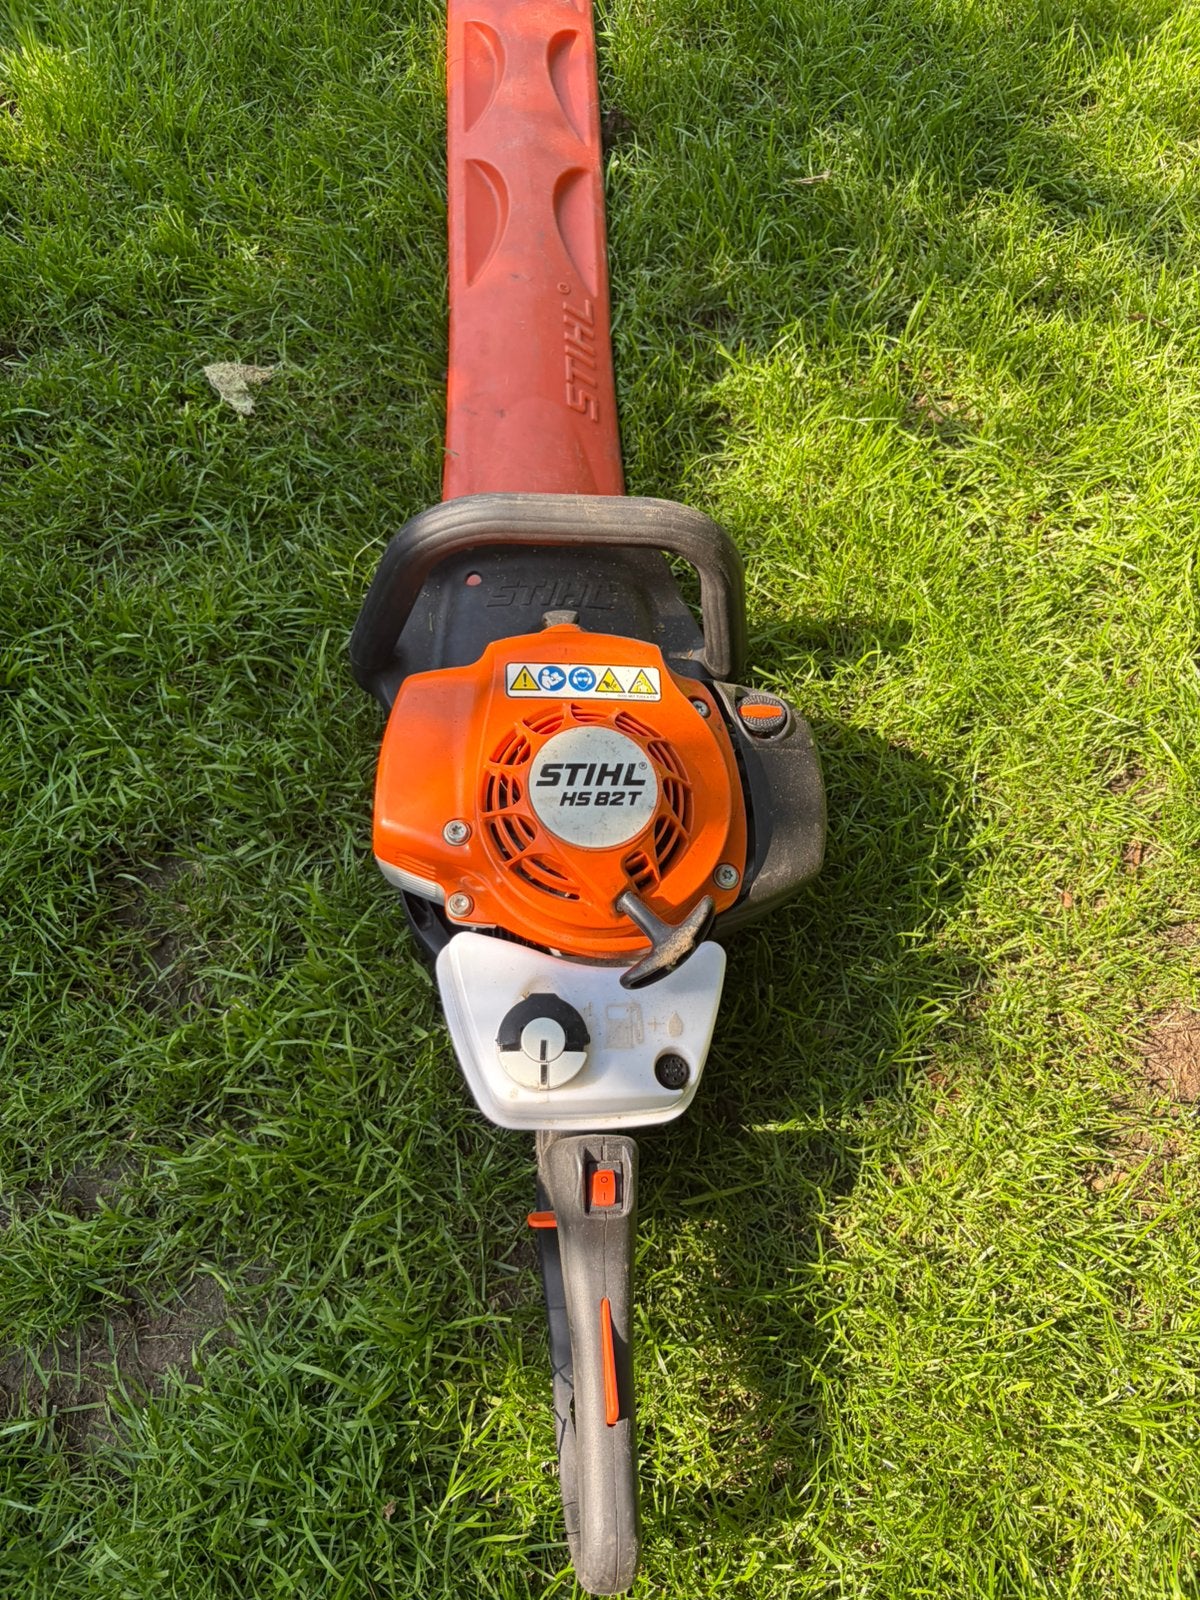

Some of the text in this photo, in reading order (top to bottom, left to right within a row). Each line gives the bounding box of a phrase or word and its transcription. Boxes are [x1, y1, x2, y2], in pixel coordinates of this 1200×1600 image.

[563, 298, 599, 423] STIHL
[486, 580, 614, 611] STIHL
[536, 763, 646, 786] STIHL
